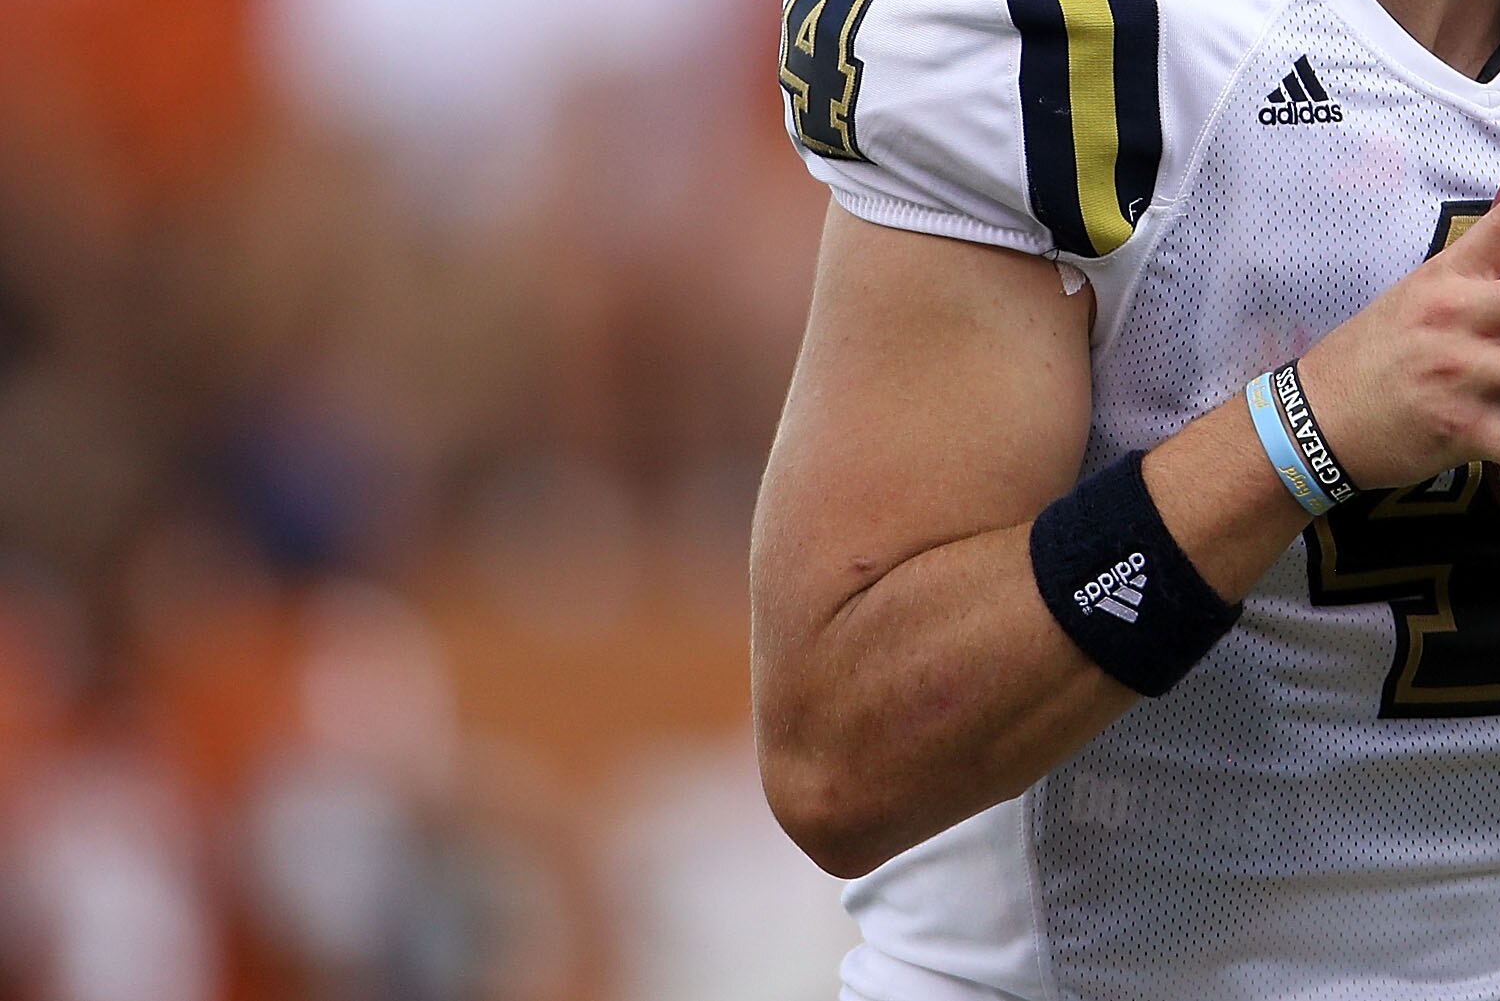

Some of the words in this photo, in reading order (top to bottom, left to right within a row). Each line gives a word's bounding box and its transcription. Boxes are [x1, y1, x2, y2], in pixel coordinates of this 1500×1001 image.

[1258, 101, 1343, 126] adidas
[1275, 366, 1341, 484] GREATNESS
[1073, 552, 1146, 606] adidas
